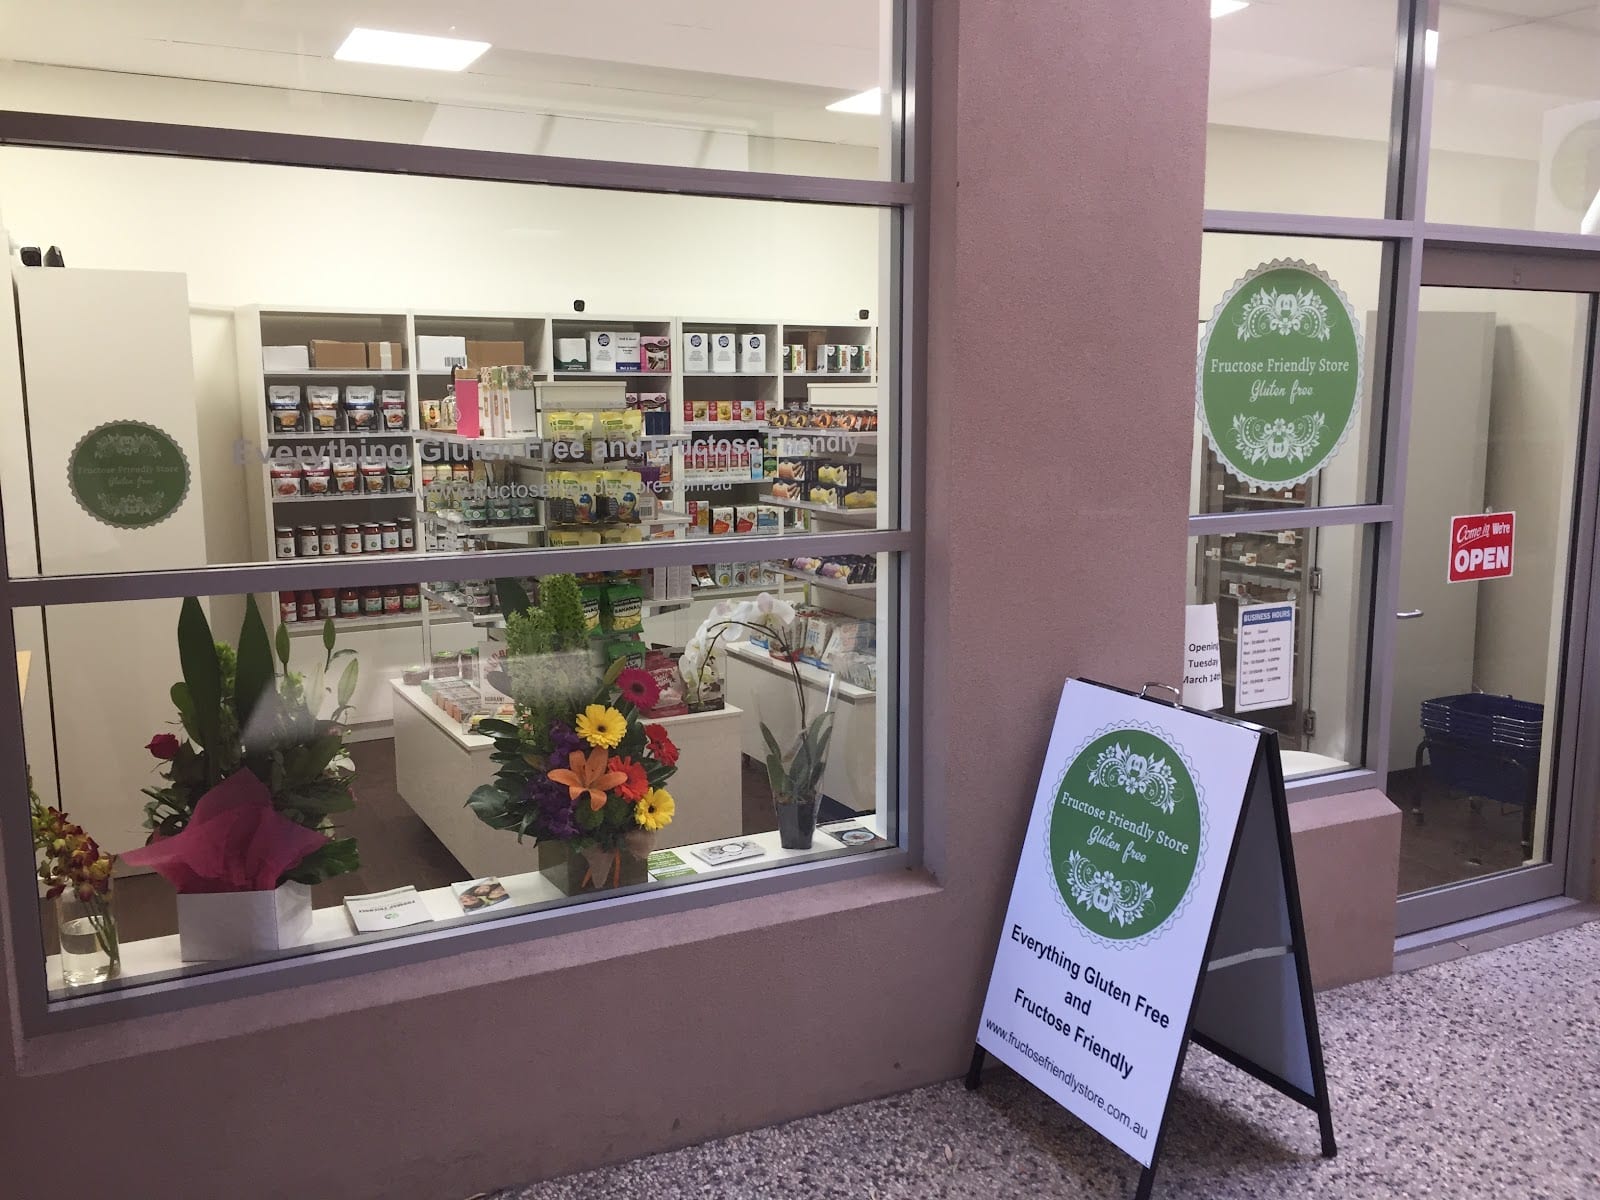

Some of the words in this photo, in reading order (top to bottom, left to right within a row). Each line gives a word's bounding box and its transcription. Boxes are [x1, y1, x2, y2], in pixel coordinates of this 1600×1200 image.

[1210, 358, 1264, 373] Fructose
[1267, 357, 1316, 376] Friendly
[1318, 358, 1350, 372] Store
[1249, 379, 1287, 402] Gluten
[1289, 379, 1313, 405] free
[232, 437, 409, 466] Everything
[419, 436, 518, 464] Gluten
[525, 437, 585, 459] Free
[594, 437, 641, 459] and
[651, 436, 760, 459] Fructose
[767, 432, 861, 457] Friendly
[414, 478, 733, 502] www.fructosefriendlore.com.au
[1456, 524, 1482, 544] Come
[1454, 546, 1509, 573] OPEN
[1243, 611, 1271, 622] BUSINESS
[1271, 609, 1291, 619] HOURS
[1060, 791, 1106, 820] Fructose
[1106, 809, 1155, 843] Friendly
[1155, 830, 1190, 855] Store
[1086, 825, 1121, 852] Gluten
[1121, 840, 1147, 864] free
[1011, 924, 1081, 980] Everything
[1083, 966, 1132, 1007] Gluten
[1134, 994, 1170, 1029] Free
[1063, 990, 1092, 1016] and
[1014, 987, 1071, 1037] Fructose
[1073, 1026, 1134, 1080] Friendly
[986, 1017, 1149, 1140] www.fructosefriendlystore.com.au
